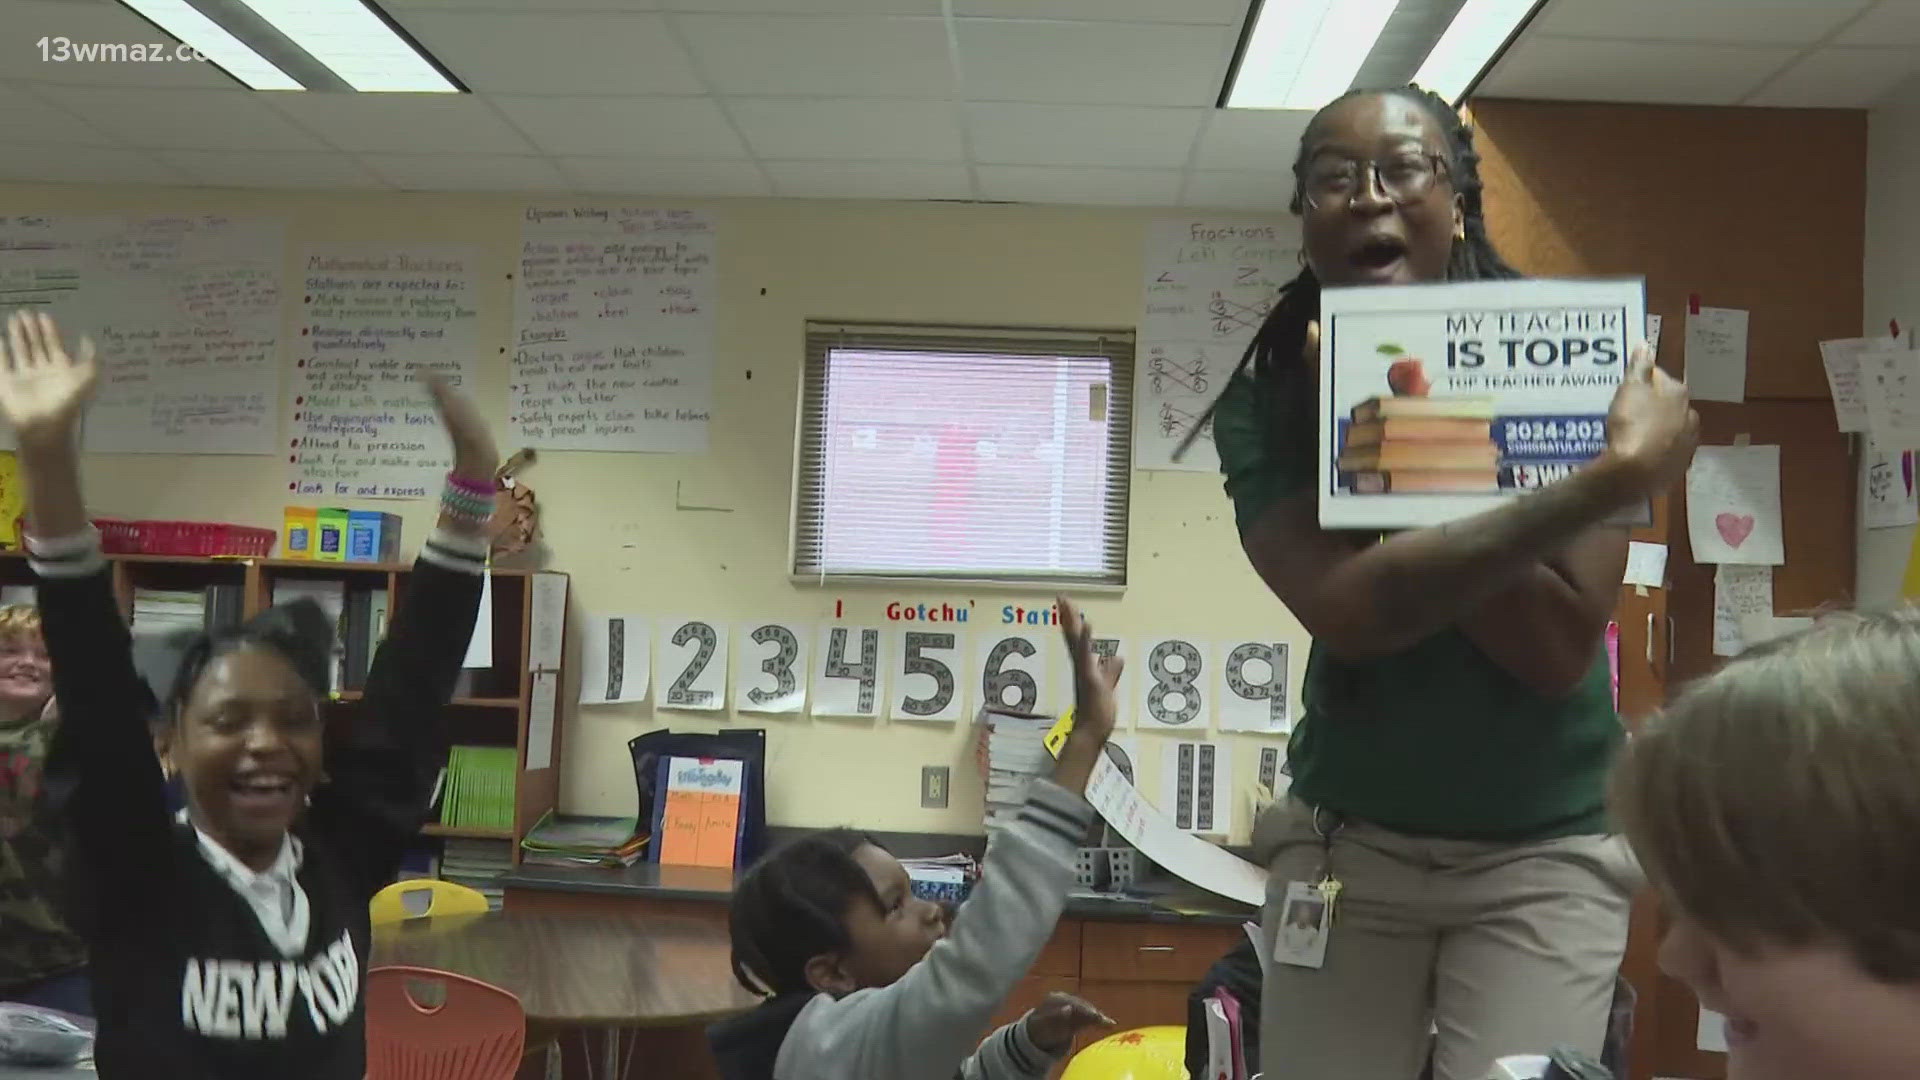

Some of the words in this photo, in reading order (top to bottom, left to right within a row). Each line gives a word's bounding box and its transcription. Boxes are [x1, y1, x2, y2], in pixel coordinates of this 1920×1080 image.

[1191, 223, 1276, 241] Fractions
[362, 279, 382, 291] are
[388, 278, 440, 292] expected
[315, 294, 345, 306] Make
[1447, 313, 1484, 334] MY
[1499, 312, 1617, 332] TEACHER
[420, 328, 444, 339] and
[312, 338, 386, 353] quantitatively
[1447, 341, 1485, 369] IS
[1498, 338, 1618, 368] TOPS
[308, 357, 360, 370] Construct
[517, 350, 564, 365] Doctors
[613, 347, 638, 359] that
[306, 371, 327, 382] and
[381, 370, 400, 382] the
[586, 378, 607, 390] the
[612, 379, 636, 389] new
[311, 381, 324, 392] of
[306, 394, 342, 409] Model
[520, 398, 555, 411] recipe
[578, 391, 617, 405] better
[331, 412, 396, 427] appropriate
[405, 412, 438, 426] tools
[519, 410, 554, 427] Safety
[558, 410, 599, 425] experts
[644, 408, 670, 422] bike
[307, 423, 379, 439] strategically
[522, 425, 546, 440] help
[551, 423, 587, 439] prevent
[595, 424, 637, 438] injuries
[1504, 419, 1604, 442] 2024-202
[299, 436, 341, 450] Attend
[349, 438, 362, 450] to
[367, 441, 426, 453] precision
[298, 453, 323, 466] Look
[332, 453, 348, 466] for
[356, 457, 377, 467] and
[382, 456, 411, 467] make
[417, 458, 438, 468] use
[302, 467, 361, 479] structure
[296, 480, 324, 495] Look
[335, 480, 350, 495] for
[357, 484, 379, 497] and
[384, 486, 426, 498] express
[836, 600, 843, 619] I
[605, 618, 625, 701] 1
[671, 621, 717, 704] 2
[747, 625, 798, 705] 3
[825, 628, 878, 714] 4
[901, 631, 955, 716] 5
[983, 636, 1038, 714] 6
[1147, 640, 1203, 725] 8
[181, 957, 298, 1040] NEW
